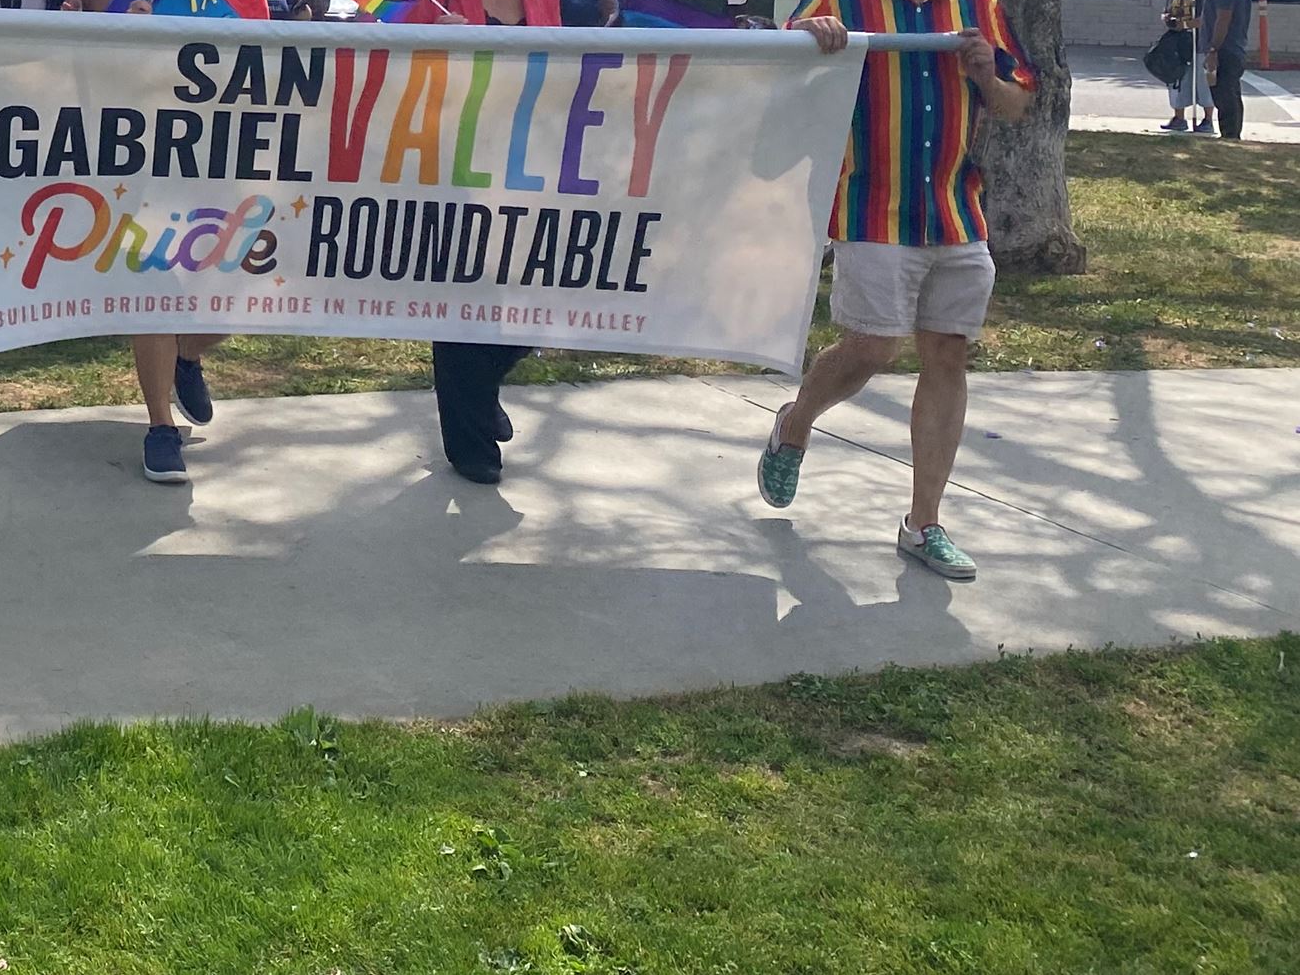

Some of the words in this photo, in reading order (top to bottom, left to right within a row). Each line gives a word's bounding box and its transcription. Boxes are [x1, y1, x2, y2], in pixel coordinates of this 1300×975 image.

[173, 41, 326, 107] SAN
[327, 46, 692, 197] VALLEY
[20, 182, 278, 290] Pride
[305, 195, 662, 293] ROUNDTABLE
[103, 295, 199, 313] BRIDGES
[210, 295, 236, 313] OF
[246, 295, 313, 314] PRIDE
[323, 297, 345, 315] IN
[357, 298, 396, 316] THE
[407, 300, 448, 320] SAN
[460, 302, 554, 326] GABRIEL
[567, 309, 647, 333] VALLEY
